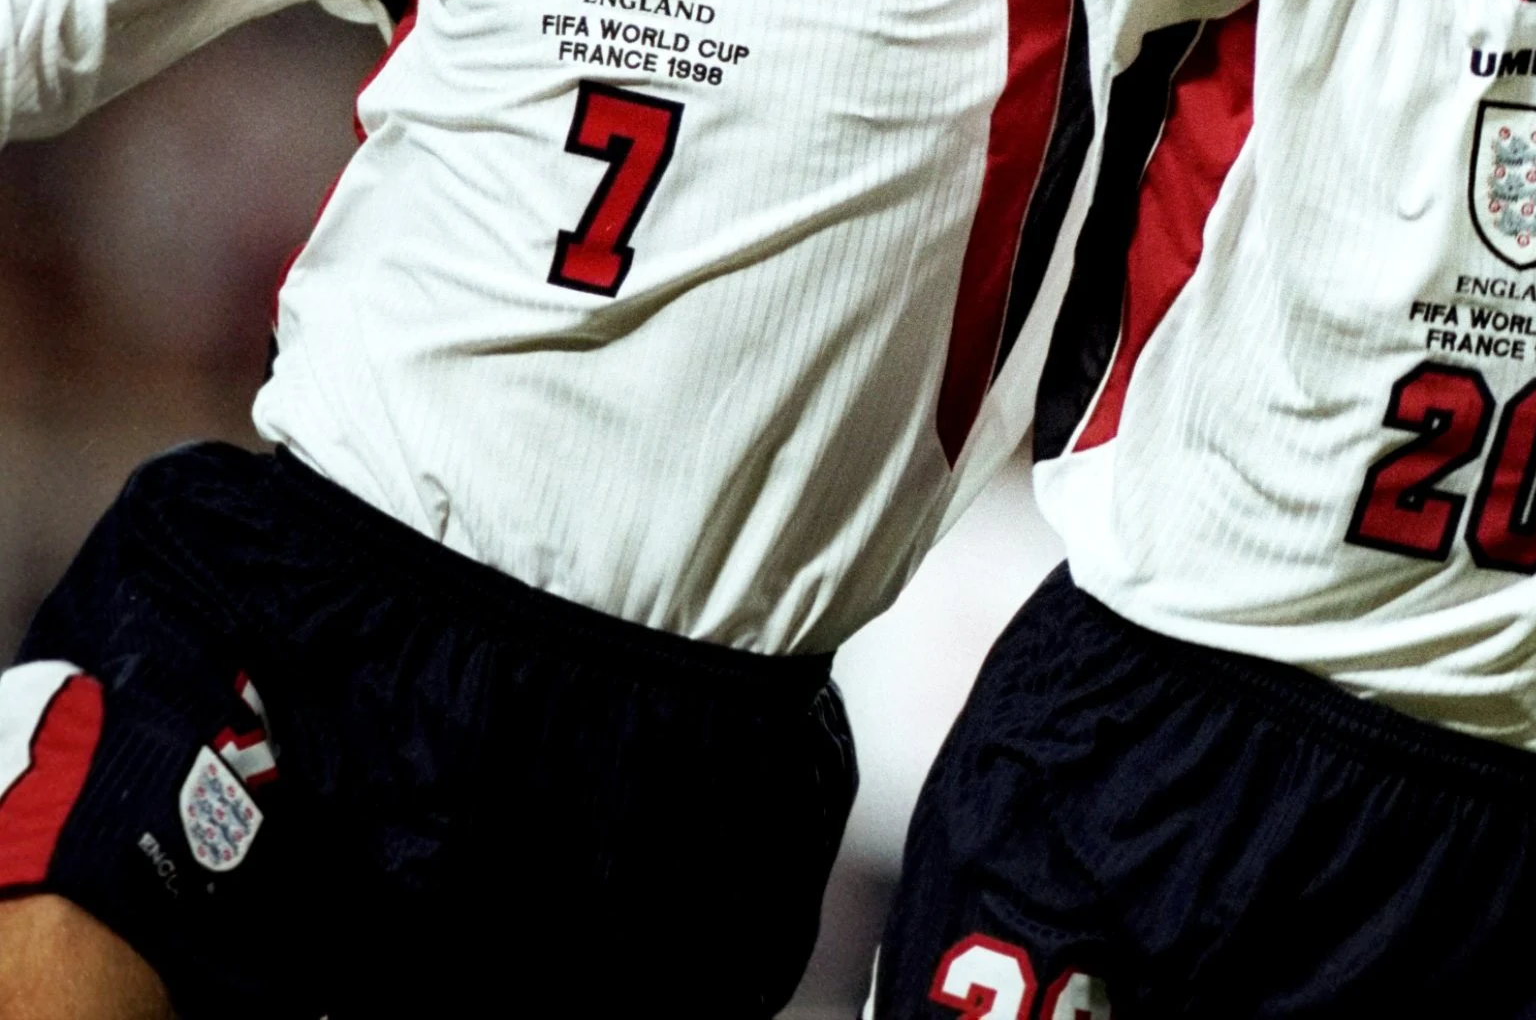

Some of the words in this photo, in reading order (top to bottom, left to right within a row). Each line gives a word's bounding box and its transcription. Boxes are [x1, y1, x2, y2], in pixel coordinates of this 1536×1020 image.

[542, 14, 590, 37] FIFA
[600, 18, 690, 53] WORLD
[698, 39, 750, 66] CUP
[558, 41, 659, 73] FRANCE
[667, 57, 724, 86] 1998
[546, 79, 686, 299] 7
[1408, 301, 1459, 326] FIFA
[1425, 329, 1526, 361] FRANCE
